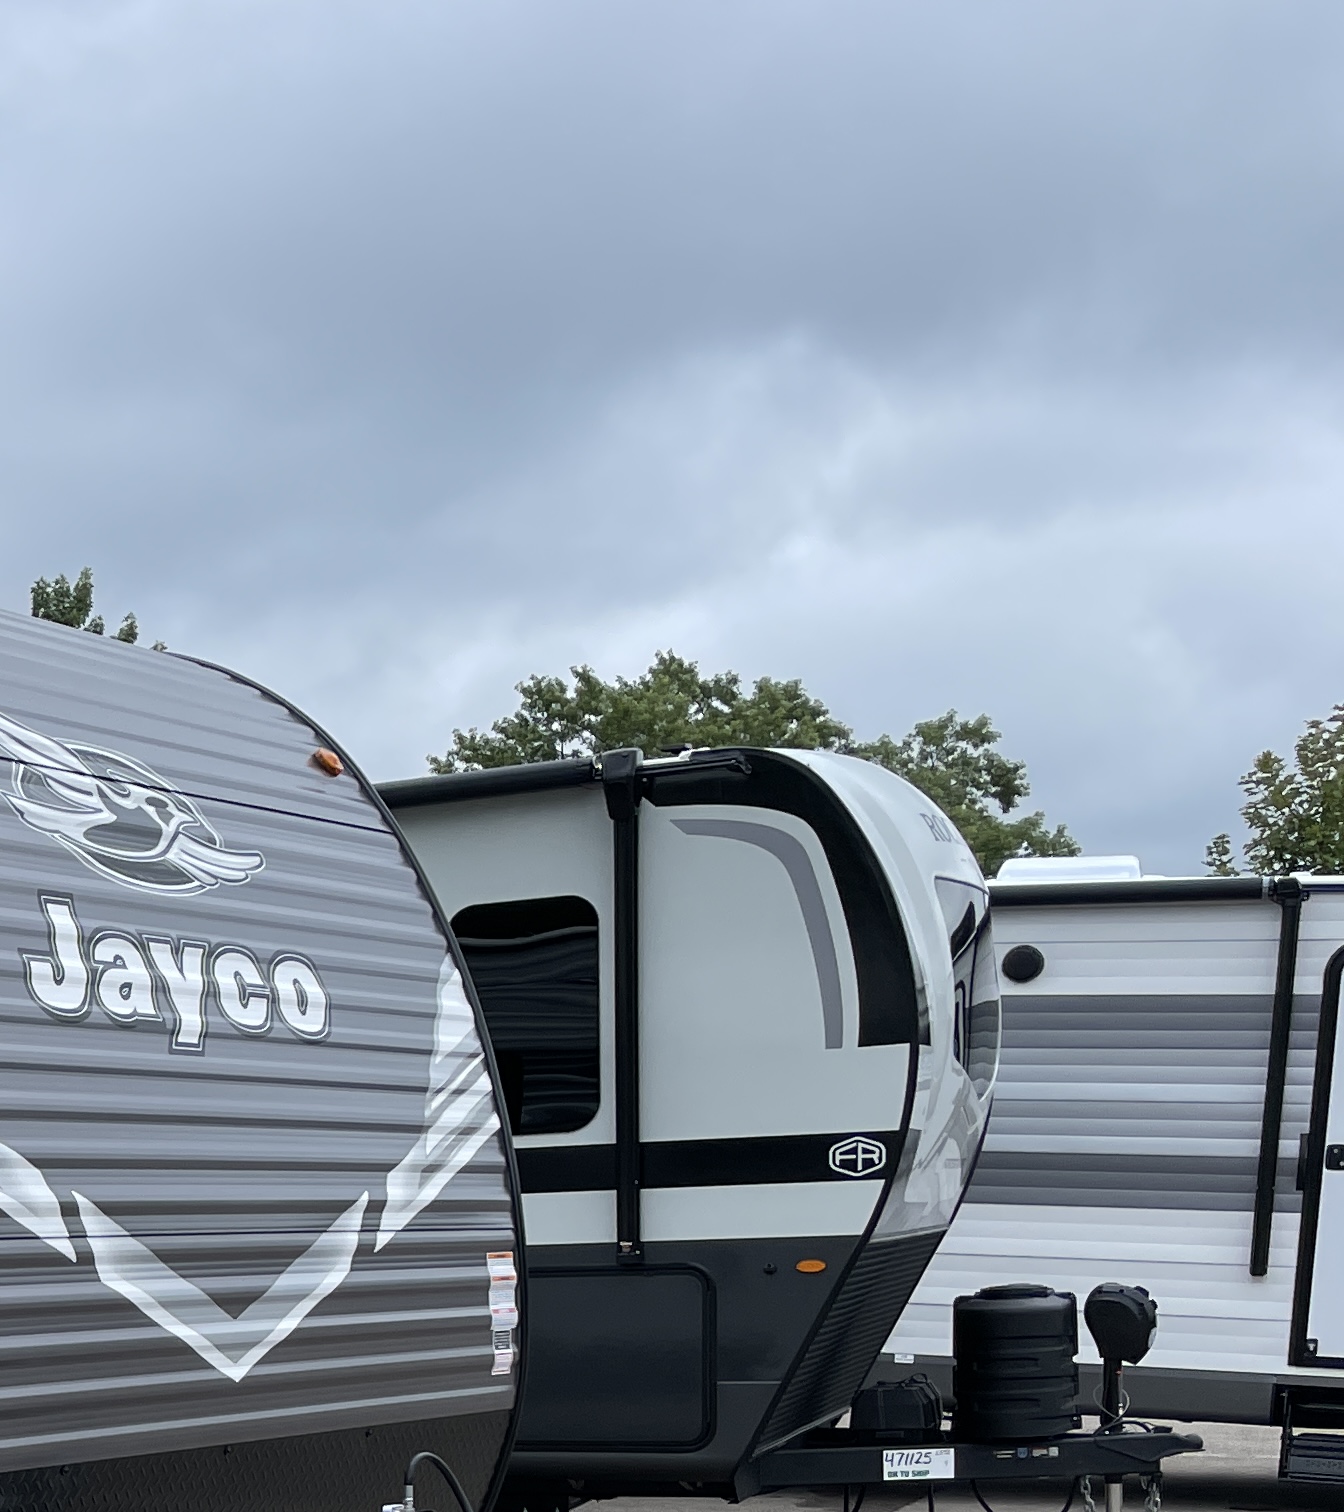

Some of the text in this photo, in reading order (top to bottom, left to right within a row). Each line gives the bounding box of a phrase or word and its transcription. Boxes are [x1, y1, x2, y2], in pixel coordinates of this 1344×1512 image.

[19, 890, 331, 1055] Jayco
[835, 1141, 880, 1171] FR
[885, 1451, 932, 1467] 471125
